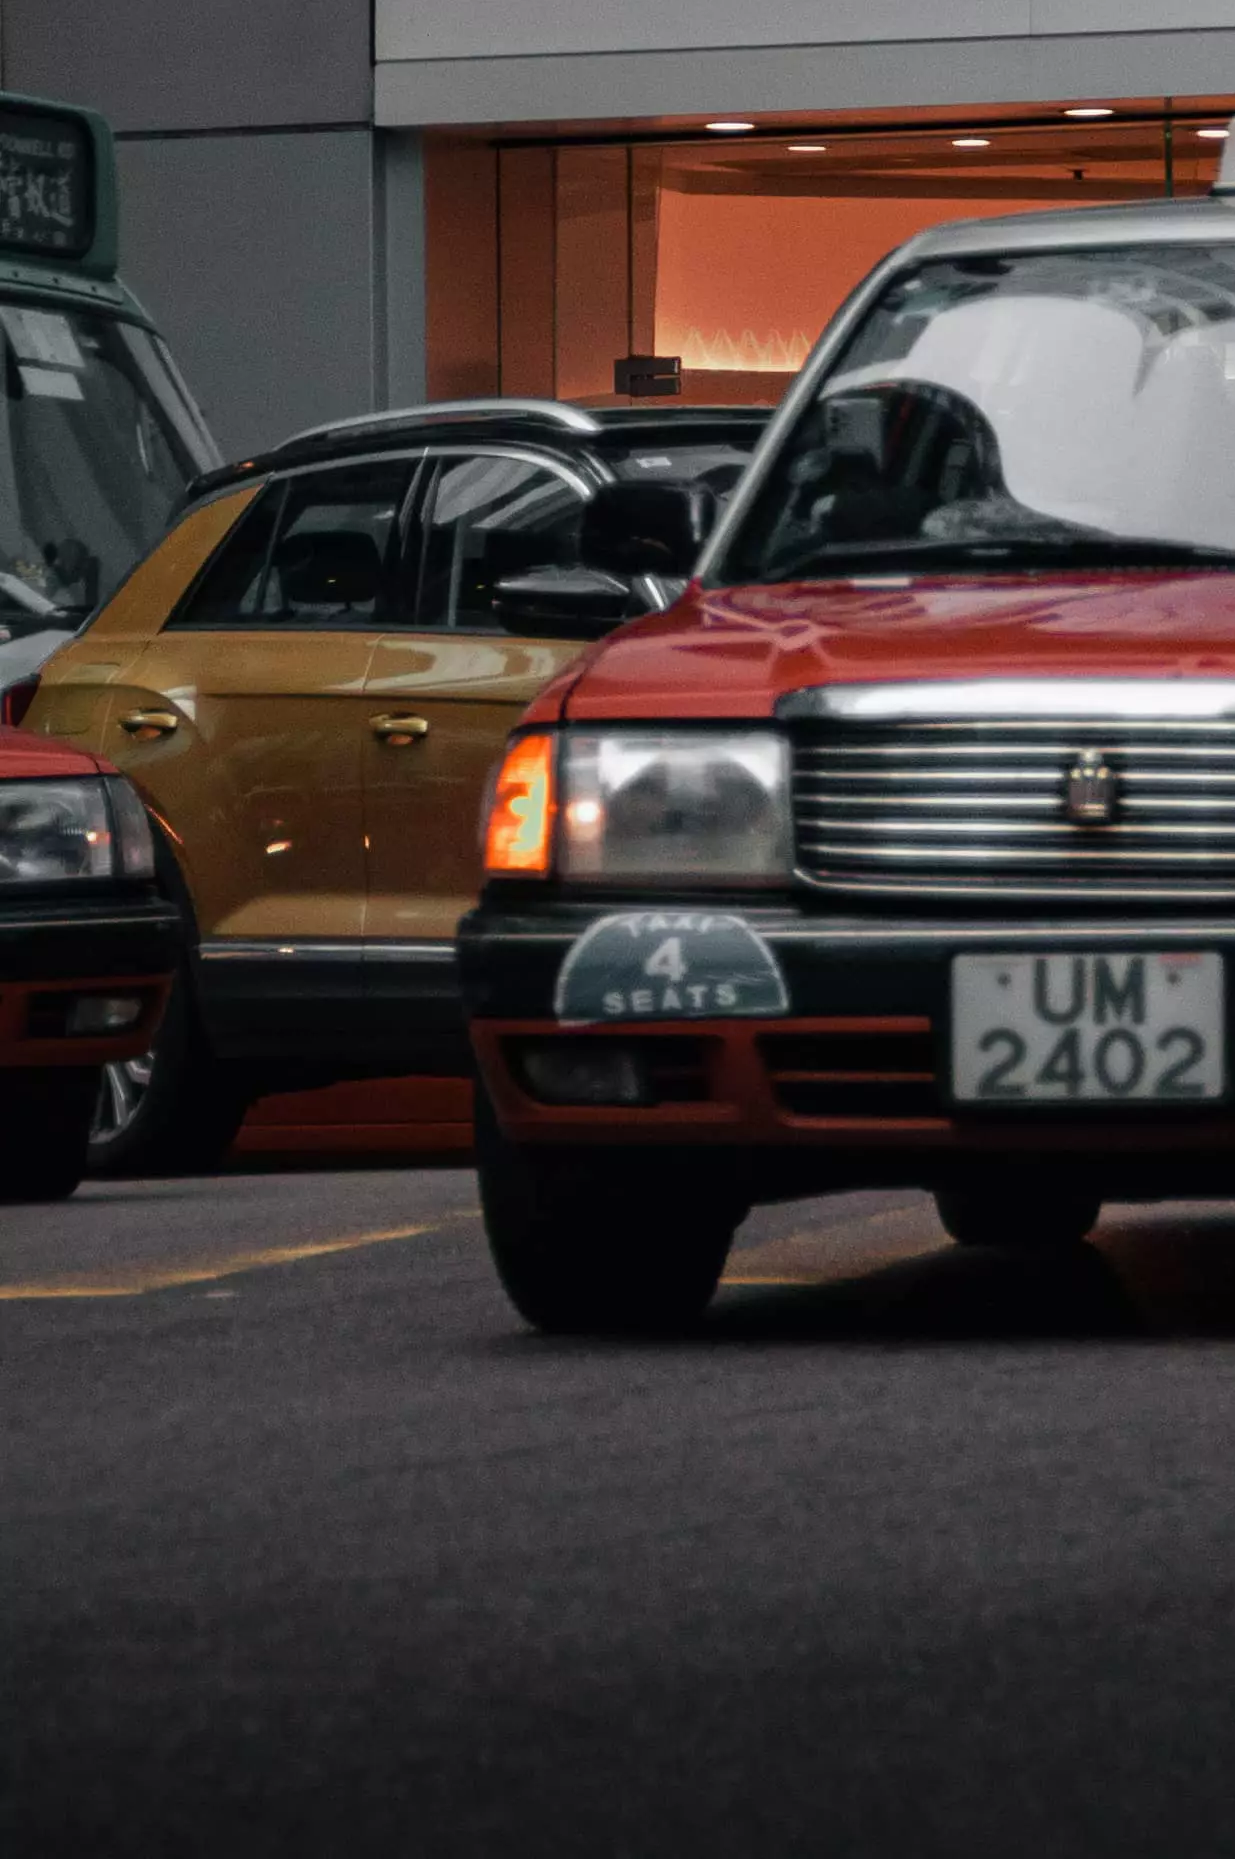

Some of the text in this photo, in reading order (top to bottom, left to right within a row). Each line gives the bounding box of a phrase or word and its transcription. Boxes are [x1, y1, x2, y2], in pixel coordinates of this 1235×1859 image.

[645, 936, 688, 982] 4
[602, 985, 738, 1016] SEATS
[1034, 958, 1146, 1025] UM
[977, 1027, 1206, 1097] 2402
